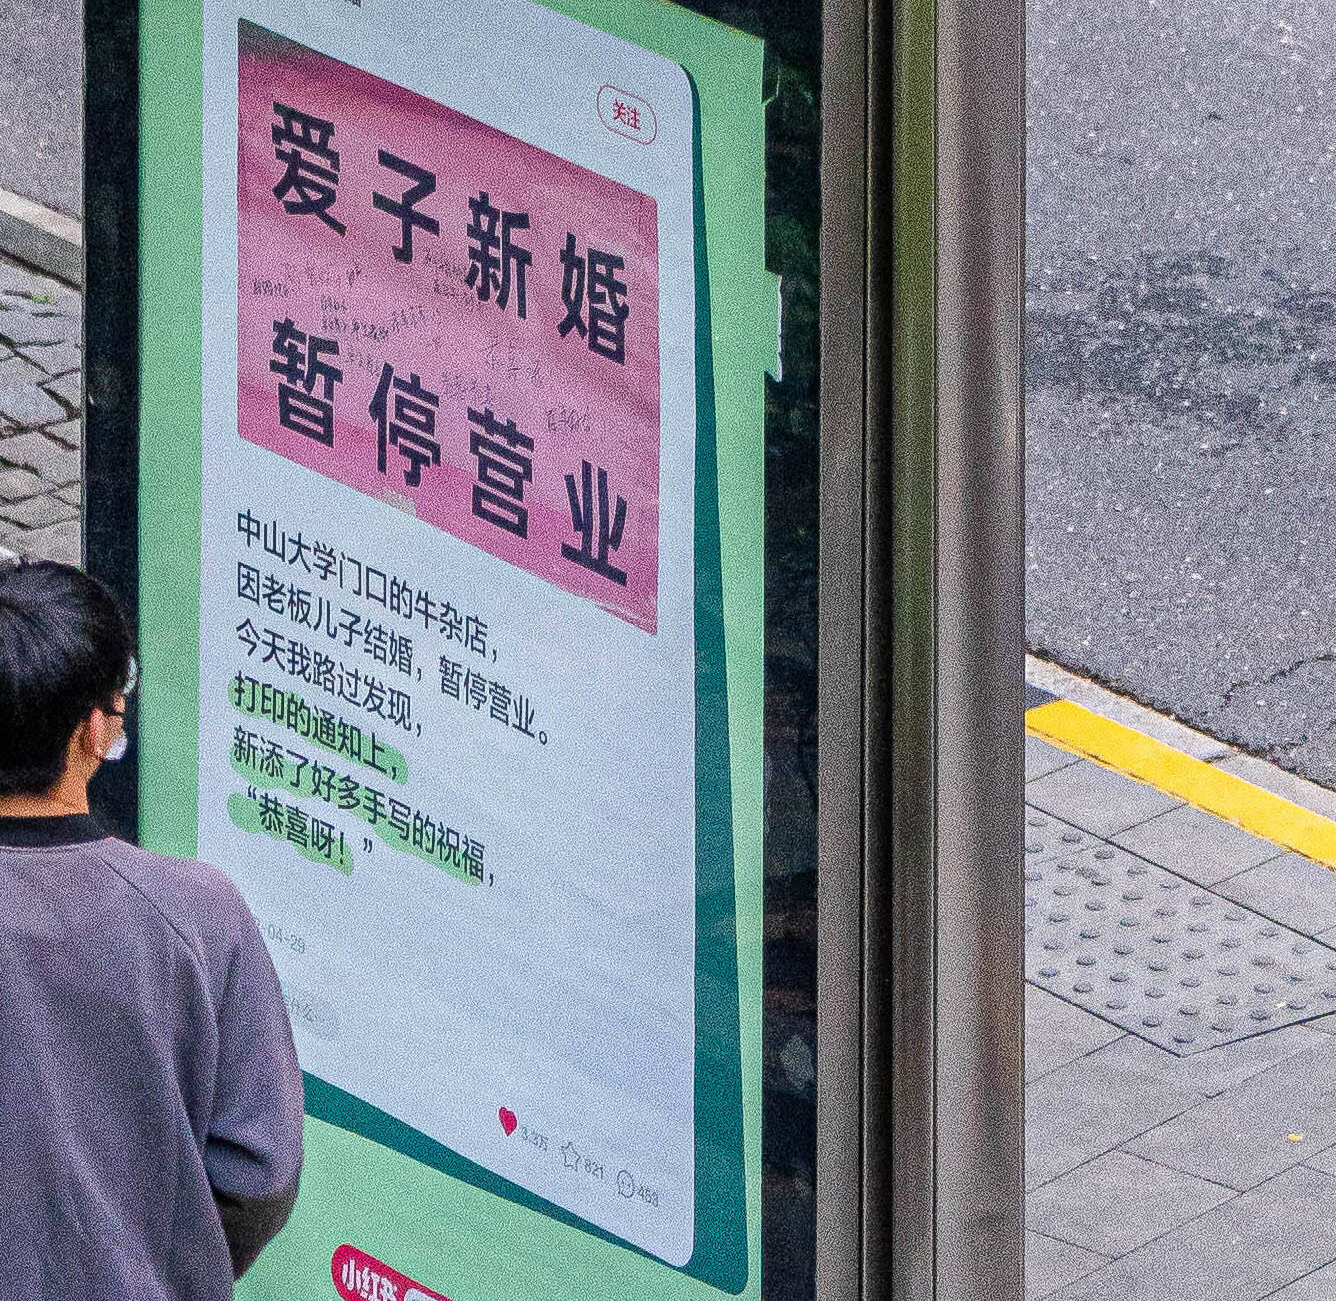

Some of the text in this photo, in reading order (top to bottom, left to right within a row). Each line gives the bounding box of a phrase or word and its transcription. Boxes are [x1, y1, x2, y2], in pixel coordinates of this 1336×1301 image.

[612, 100, 642, 131] 关注
[270, 101, 628, 366] 爱子新婚
[269, 316, 628, 587] 暂停营业
[236, 509, 499, 663] 中山大学门口的牛杂店，
[236, 562, 549, 746] 因老板儿子结婚，暂停营业。
[233, 671, 399, 780] 打印的通知上，
[235, 618, 423, 737] 今天我路过发现，
[233, 726, 495, 887] 新添了好多手写的祝福，
